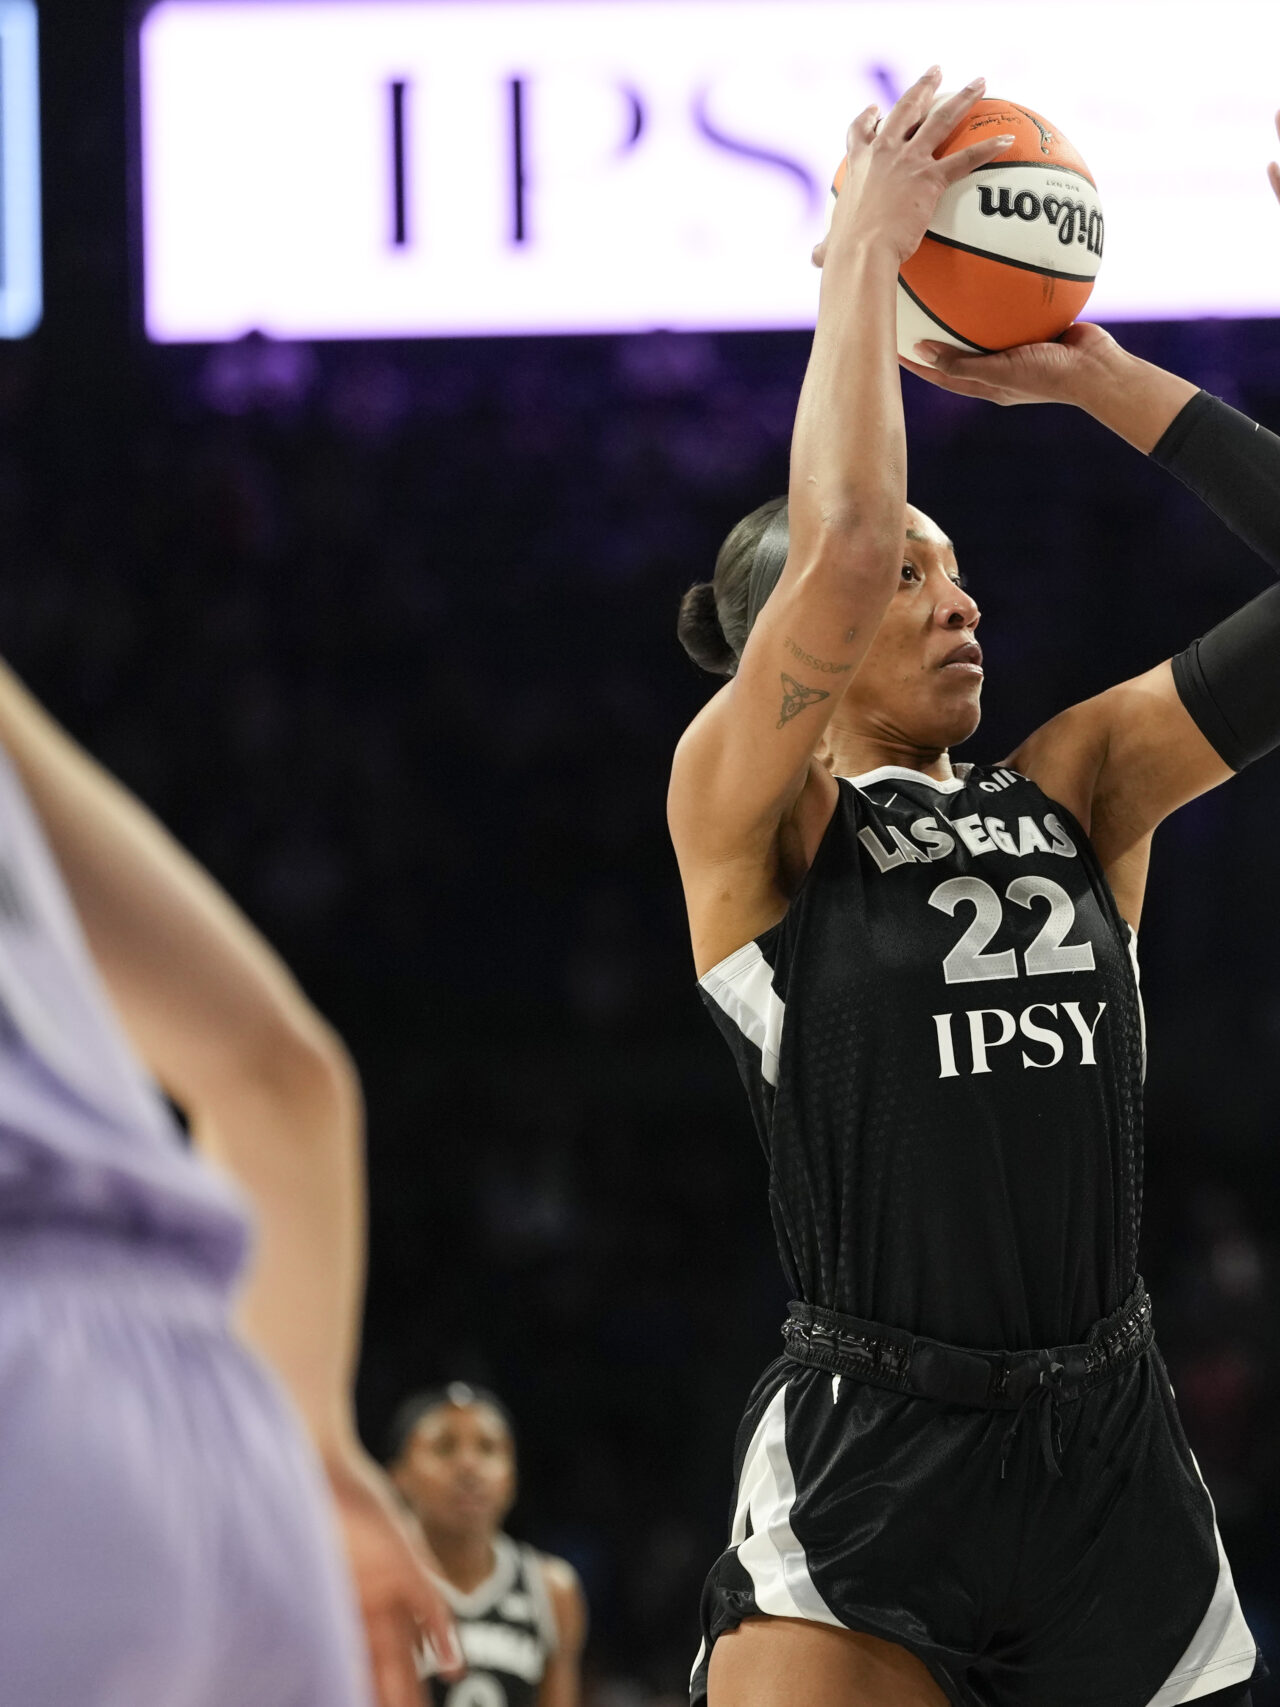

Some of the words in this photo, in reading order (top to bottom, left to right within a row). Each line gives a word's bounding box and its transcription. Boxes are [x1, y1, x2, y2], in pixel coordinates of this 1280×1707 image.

[976, 184, 1104, 259] Wilson
[857, 816, 956, 874] LAS
[935, 806, 1078, 858] EGAS
[928, 875, 1096, 985] 22
[931, 1001, 1107, 1079] IPSY
